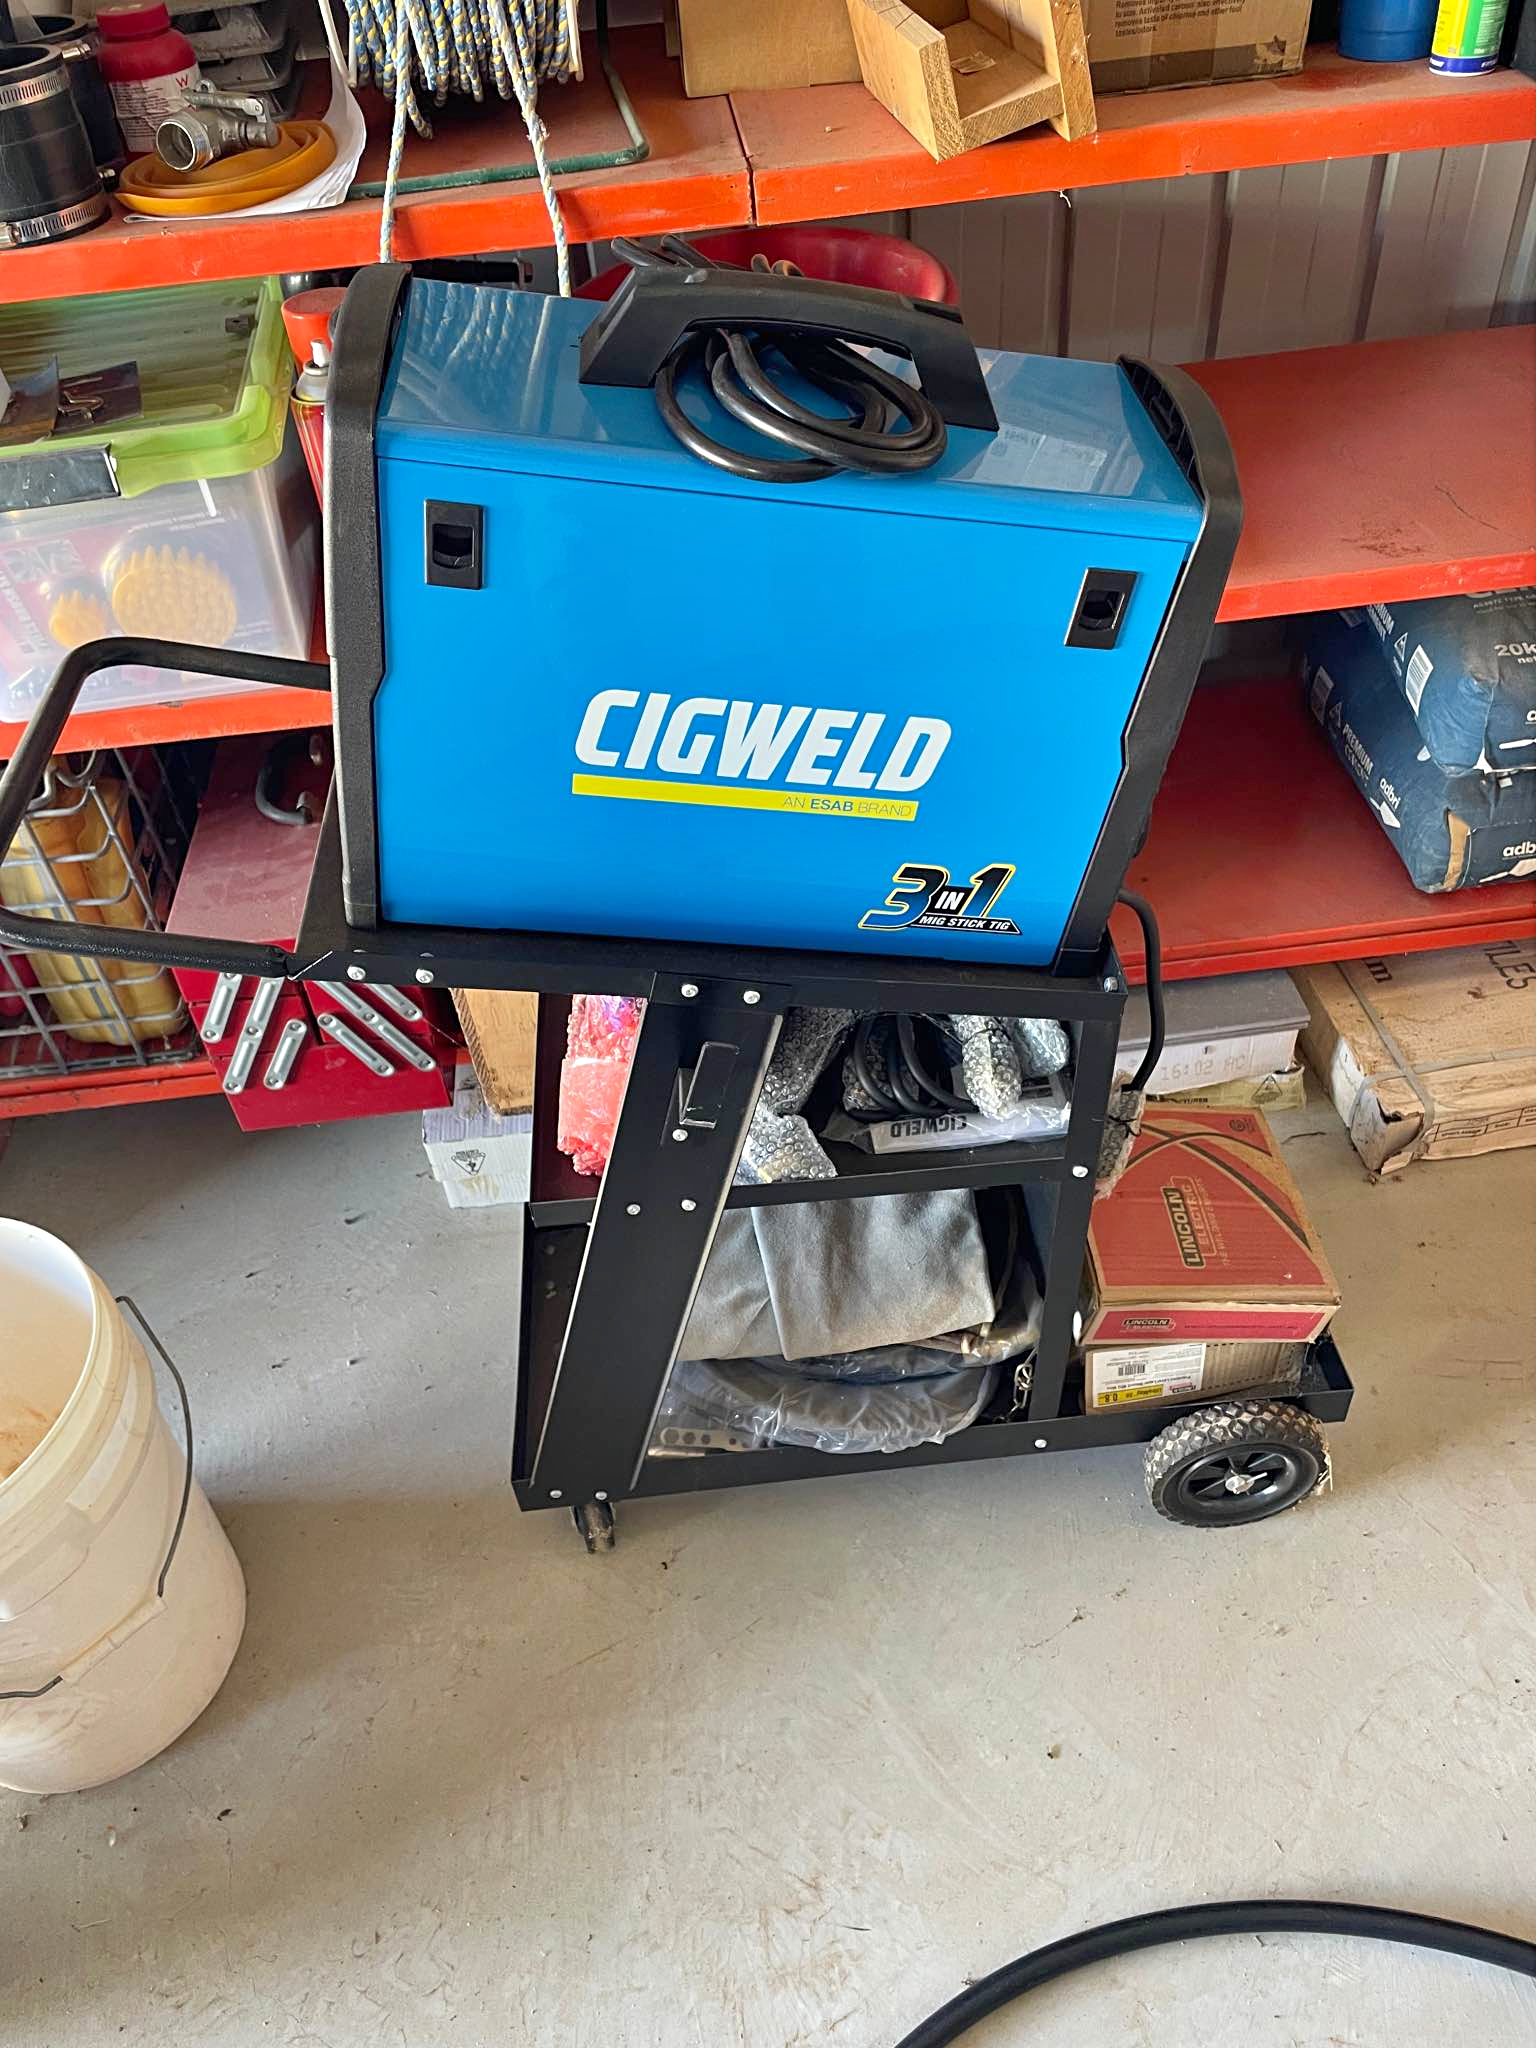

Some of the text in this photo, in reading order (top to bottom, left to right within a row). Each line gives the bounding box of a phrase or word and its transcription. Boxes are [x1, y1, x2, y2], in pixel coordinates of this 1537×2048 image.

[575, 689, 952, 792] CIGWELD
[1342, 723, 1374, 775] PREMIUM
[783, 796, 912, 817] AN ESAB BRAND
[1380, 778, 1401, 811] adbri
[858, 863, 1016, 931] 3 IN 1
[919, 915, 1012, 931] MIG STICK TIG
[890, 1115, 968, 1138] CIGWELD
[1166, 1190, 1202, 1264] LINCOLN
[1182, 1184, 1210, 1247] ELECTRIC
[1124, 1318, 1170, 1326] LINCOLN
